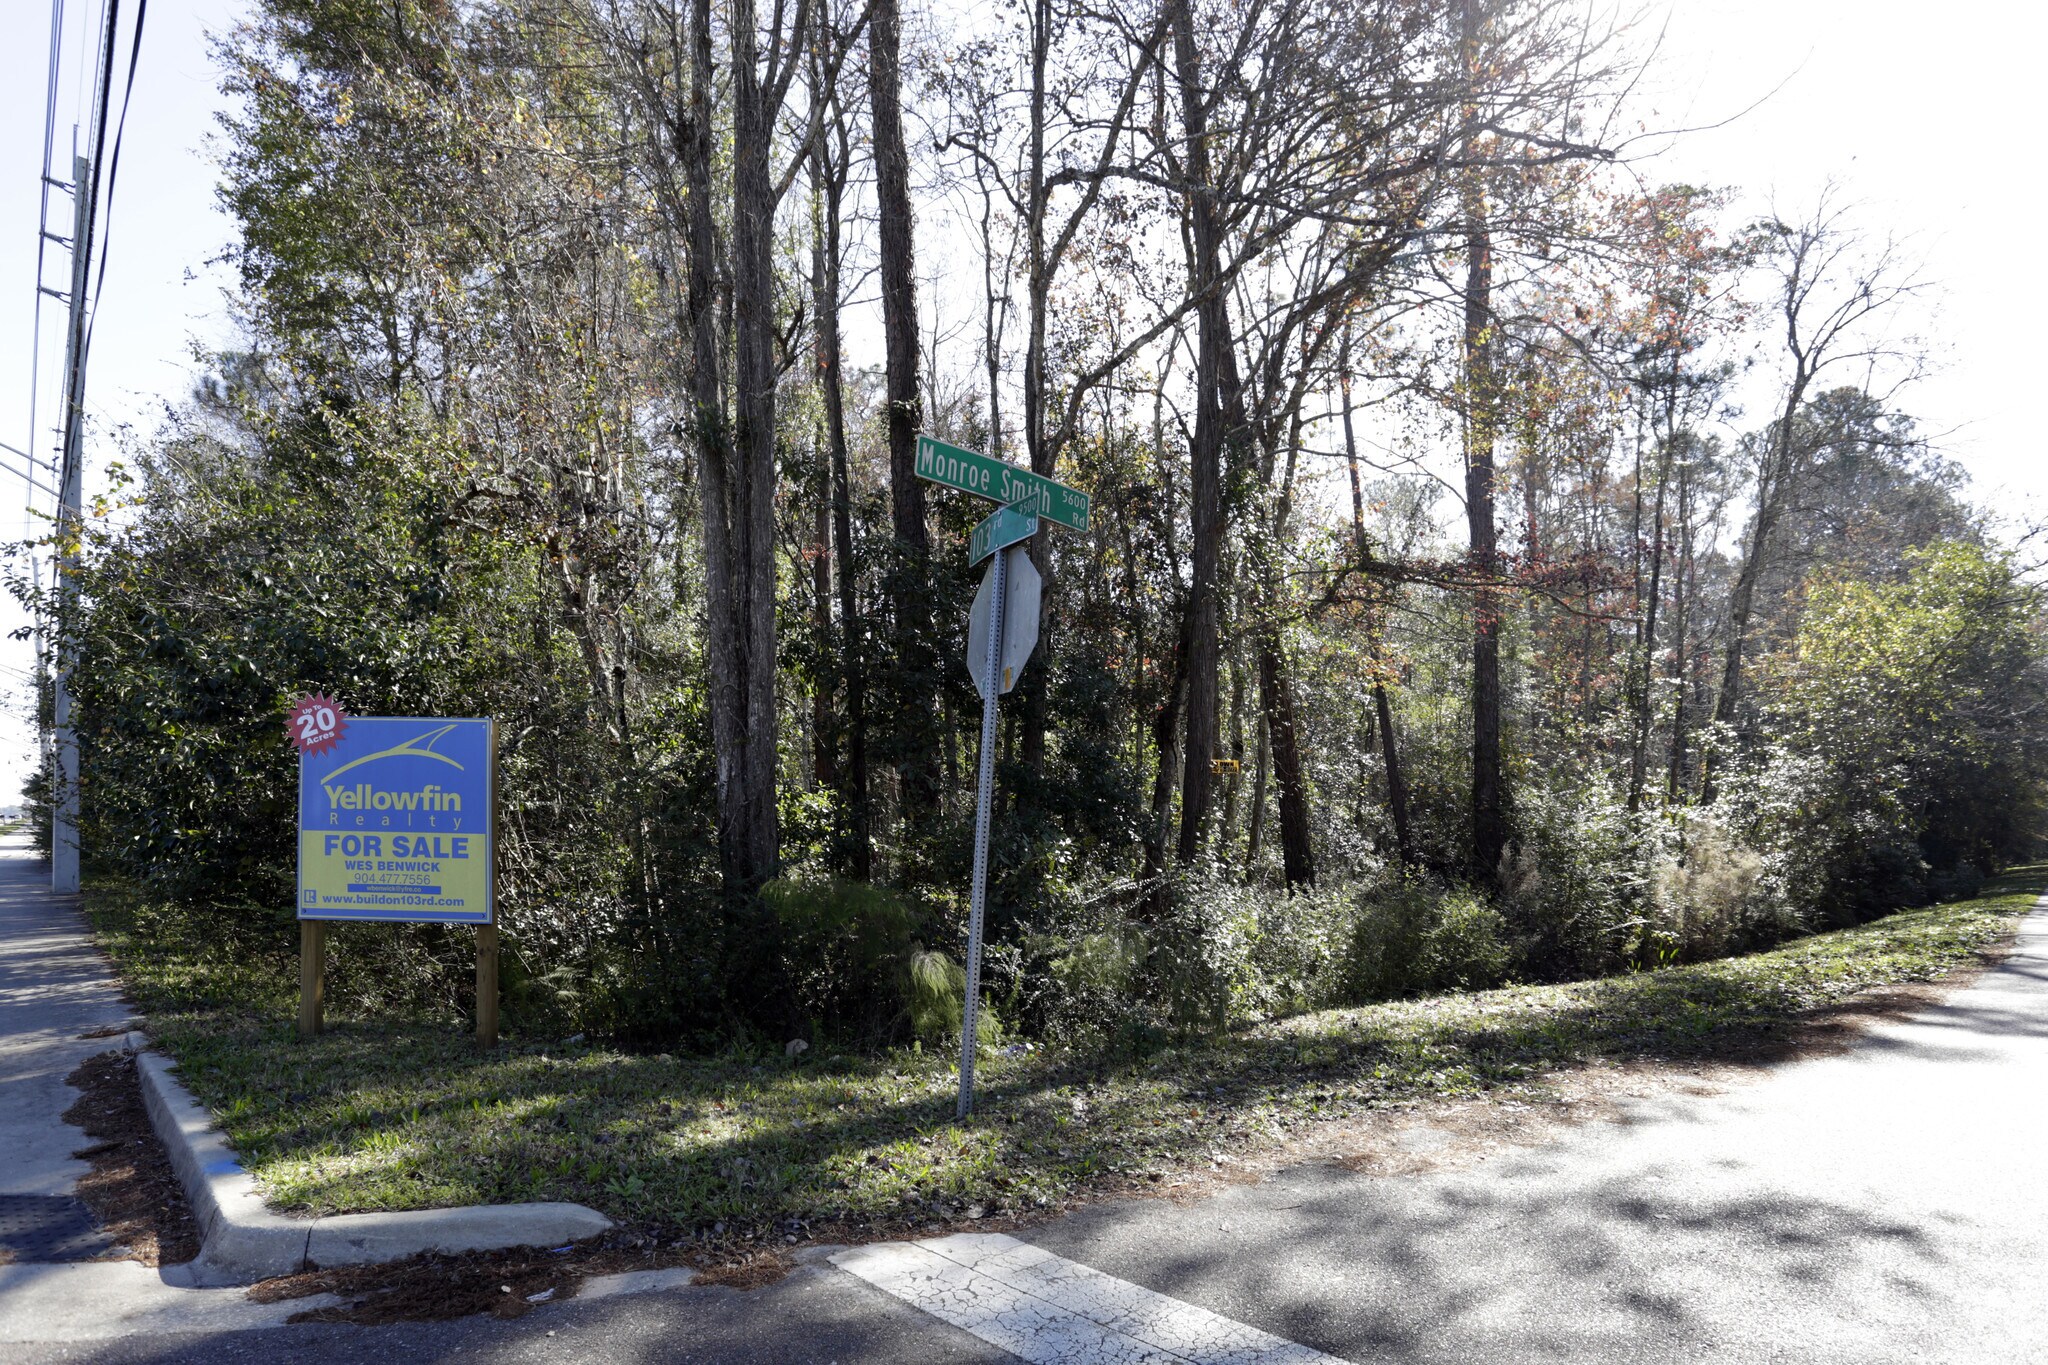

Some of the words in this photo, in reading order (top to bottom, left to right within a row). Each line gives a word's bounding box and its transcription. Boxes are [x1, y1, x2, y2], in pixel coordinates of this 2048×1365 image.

[921, 442, 990, 491] Monroe
[1018, 497, 1037, 516] 9500
[1062, 490, 1086, 511] 5600
[1025, 517, 1035, 532] St
[1072, 513, 1085, 528] Rd
[296, 707, 336, 740] 20
[306, 730, 335, 746] Acres
[323, 784, 462, 811] Yellowfin
[329, 812, 462, 831] Realty
[324, 834, 382, 857] FOR
[392, 835, 469, 859] SALE
[345, 860, 373, 871] WES
[377, 861, 441, 872] BENWICK
[354, 873, 431, 885] 904.477.7556
[322, 894, 465, 907] www.buildon103rd.com
